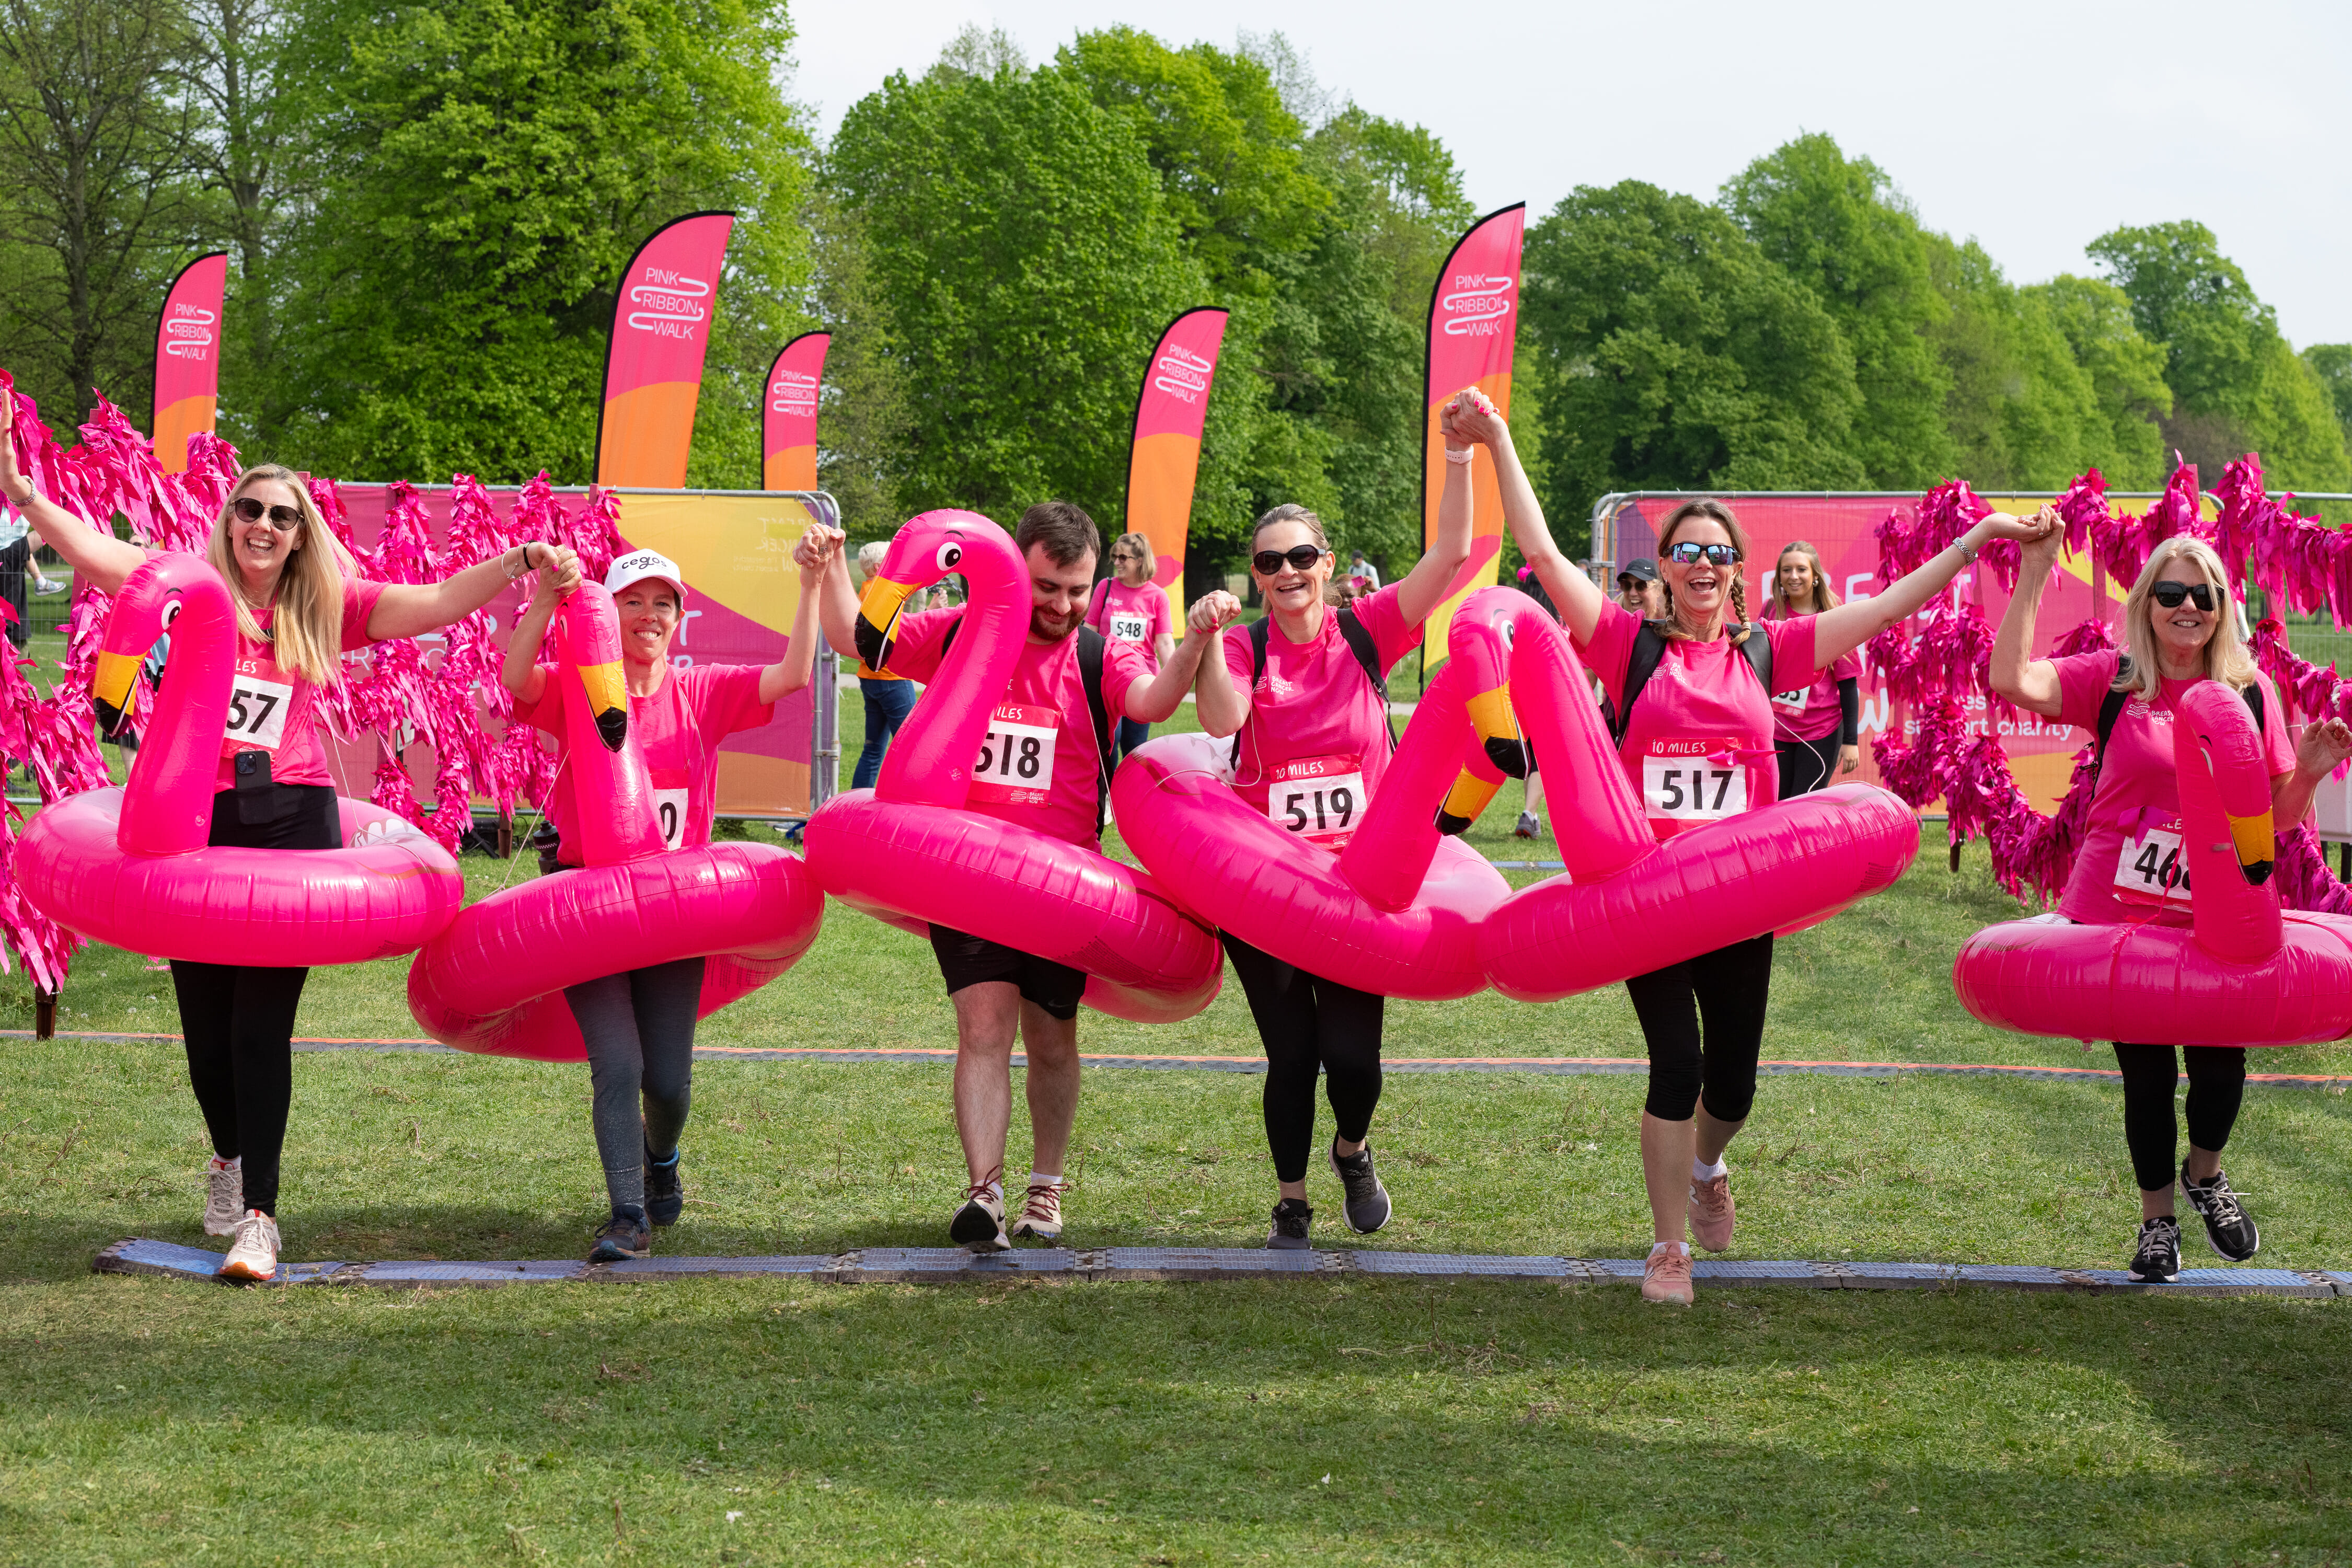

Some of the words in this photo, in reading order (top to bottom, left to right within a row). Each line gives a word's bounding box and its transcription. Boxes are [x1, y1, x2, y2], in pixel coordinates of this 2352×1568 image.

[645, 267, 680, 286] PINK
[1456, 273, 1485, 289] PINK
[175, 303, 197, 317] PINK
[642, 293, 698, 315] RIBBON
[1456, 296, 1503, 313] RIBBON
[174, 326, 209, 340] RIBBON
[653, 320, 694, 340] WALK
[1467, 320, 1500, 337] WALK
[181, 347, 206, 361] WALK
[1169, 343, 1192, 361] PINK
[781, 370, 802, 382] PINK
[1166, 363, 1202, 386] RIBBON
[780, 387, 815, 401] RIBBON
[1171, 385, 1197, 405] WALK
[788, 405, 814, 418] WALK
[621, 557, 667, 570] cegos
[1117, 621, 1141, 638] 548
[236, 658, 257, 674] LES
[1271, 682, 1294, 691] CANCER
[1272, 676, 1293, 687] BREAST
[1271, 687, 1284, 695] NOW
[226, 689, 279, 734] 57
[997, 706, 1022, 720] ILES
[974, 732, 1041, 779] 518
[1653, 741, 1664, 754] 10
[1668, 742, 1706, 753] MILES
[1276, 768, 1286, 779] 10
[1288, 761, 1324, 777] MILES
[1662, 770, 1734, 810] 517
[1286, 787, 1353, 832] 519
